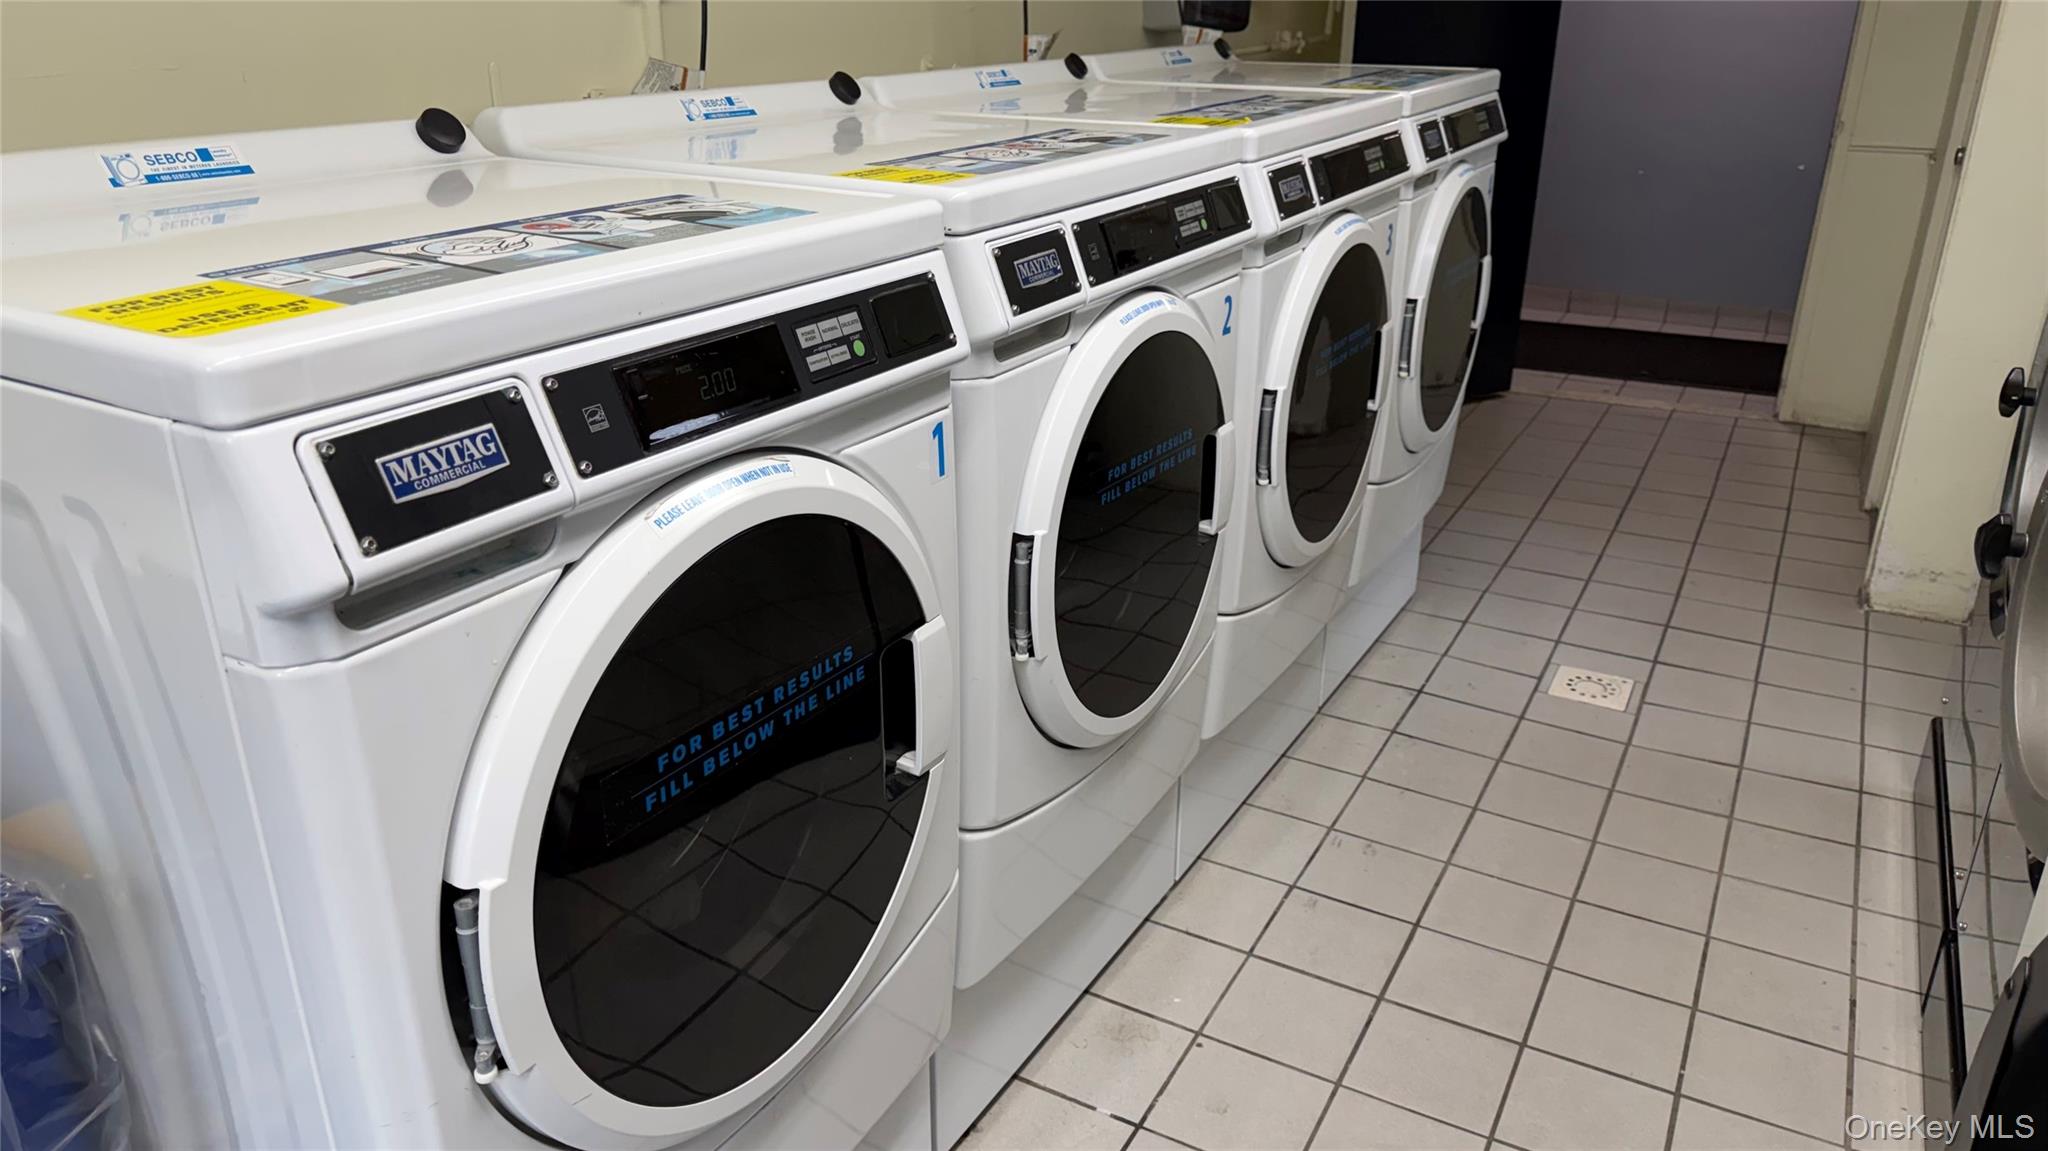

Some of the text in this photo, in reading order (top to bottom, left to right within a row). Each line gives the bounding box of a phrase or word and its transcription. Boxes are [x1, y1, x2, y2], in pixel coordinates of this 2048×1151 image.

[143, 151, 197, 166] SEBCO
[1386, 223, 1394, 256] 3
[1018, 253, 1059, 280] MAYTAG
[88, 285, 215, 313] FOR BEST
[107, 289, 226, 315] RESULTS
[156, 299, 310, 334] DETERGENT
[177, 307, 234, 323] USE
[1222, 295, 1232, 336] 2
[697, 367, 737, 400] 2.00
[385, 432, 498, 487] MAYTAG
[932, 421, 945, 478] 1
[1107, 427, 1194, 481] FOR BEST RESULTS
[413, 460, 487, 491] COMMERCIAL
[1101, 444, 1197, 506] FILL BELOW THE LINE
[653, 504, 685, 529] PLEASE
[721, 475, 743, 491] OPEN
[740, 469, 762, 484] WHEN
[758, 465, 775, 477] NOT
[771, 464, 781, 474] IN
[779, 463, 793, 473] USE
[656, 643, 856, 774] FOR BEST RESULTS
[644, 663, 867, 814] FILL BELOW THE LINE
